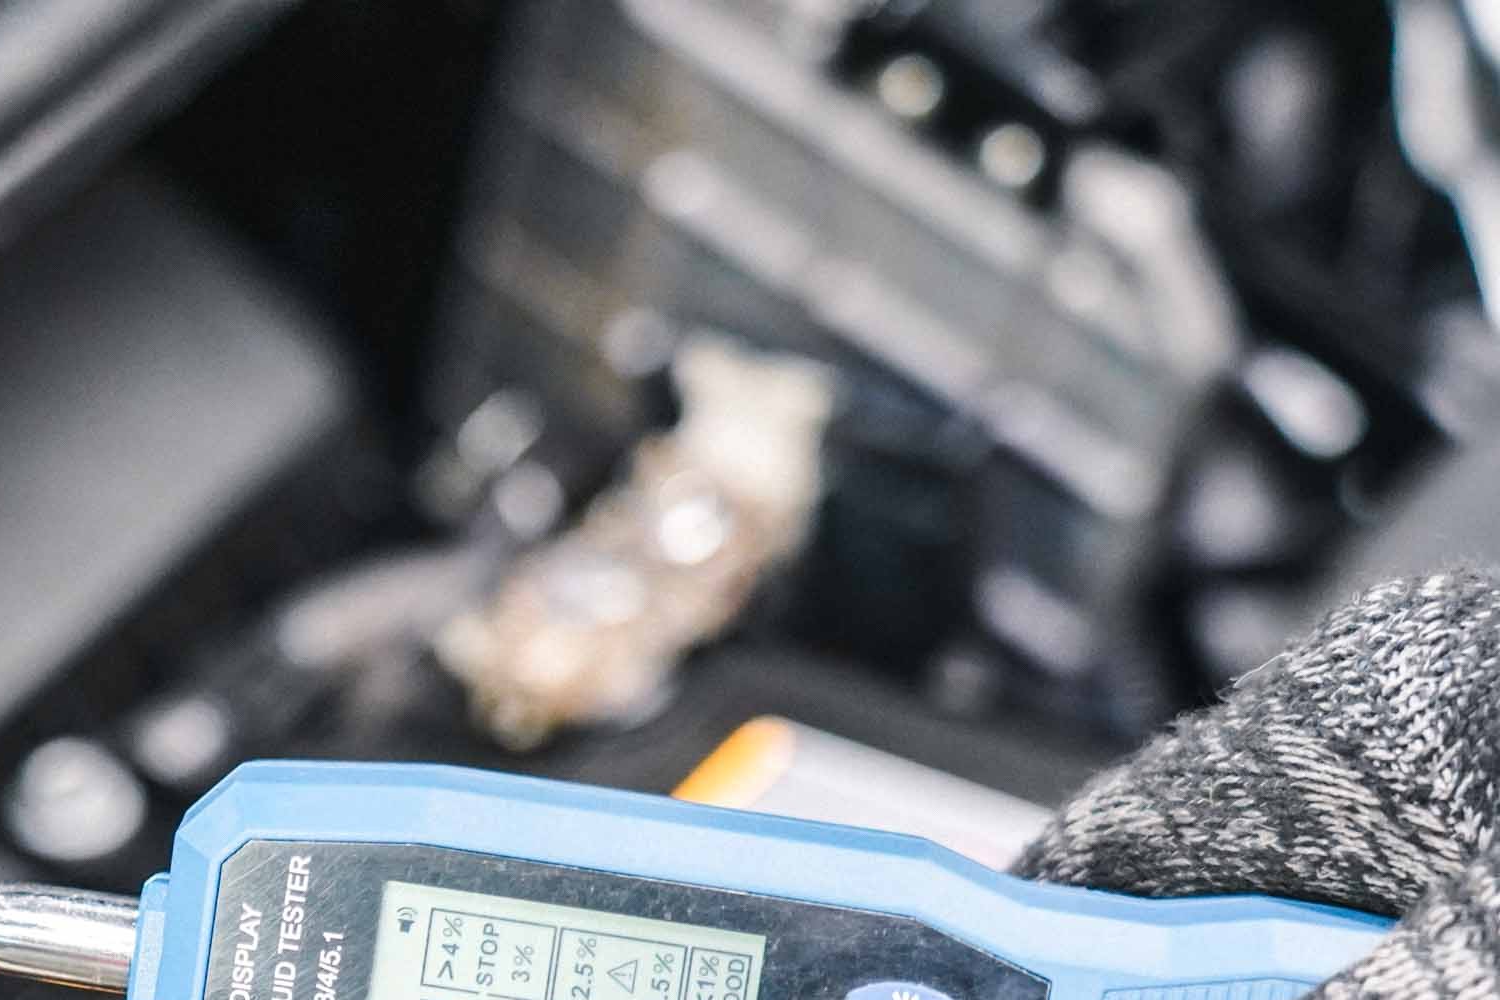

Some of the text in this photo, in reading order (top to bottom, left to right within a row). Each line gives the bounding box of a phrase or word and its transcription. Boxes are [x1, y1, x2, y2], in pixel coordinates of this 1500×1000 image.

[278, 855, 312, 955] TESTER
[476, 922, 501, 987] STOP
[571, 936, 598, 1000] 2.5%
